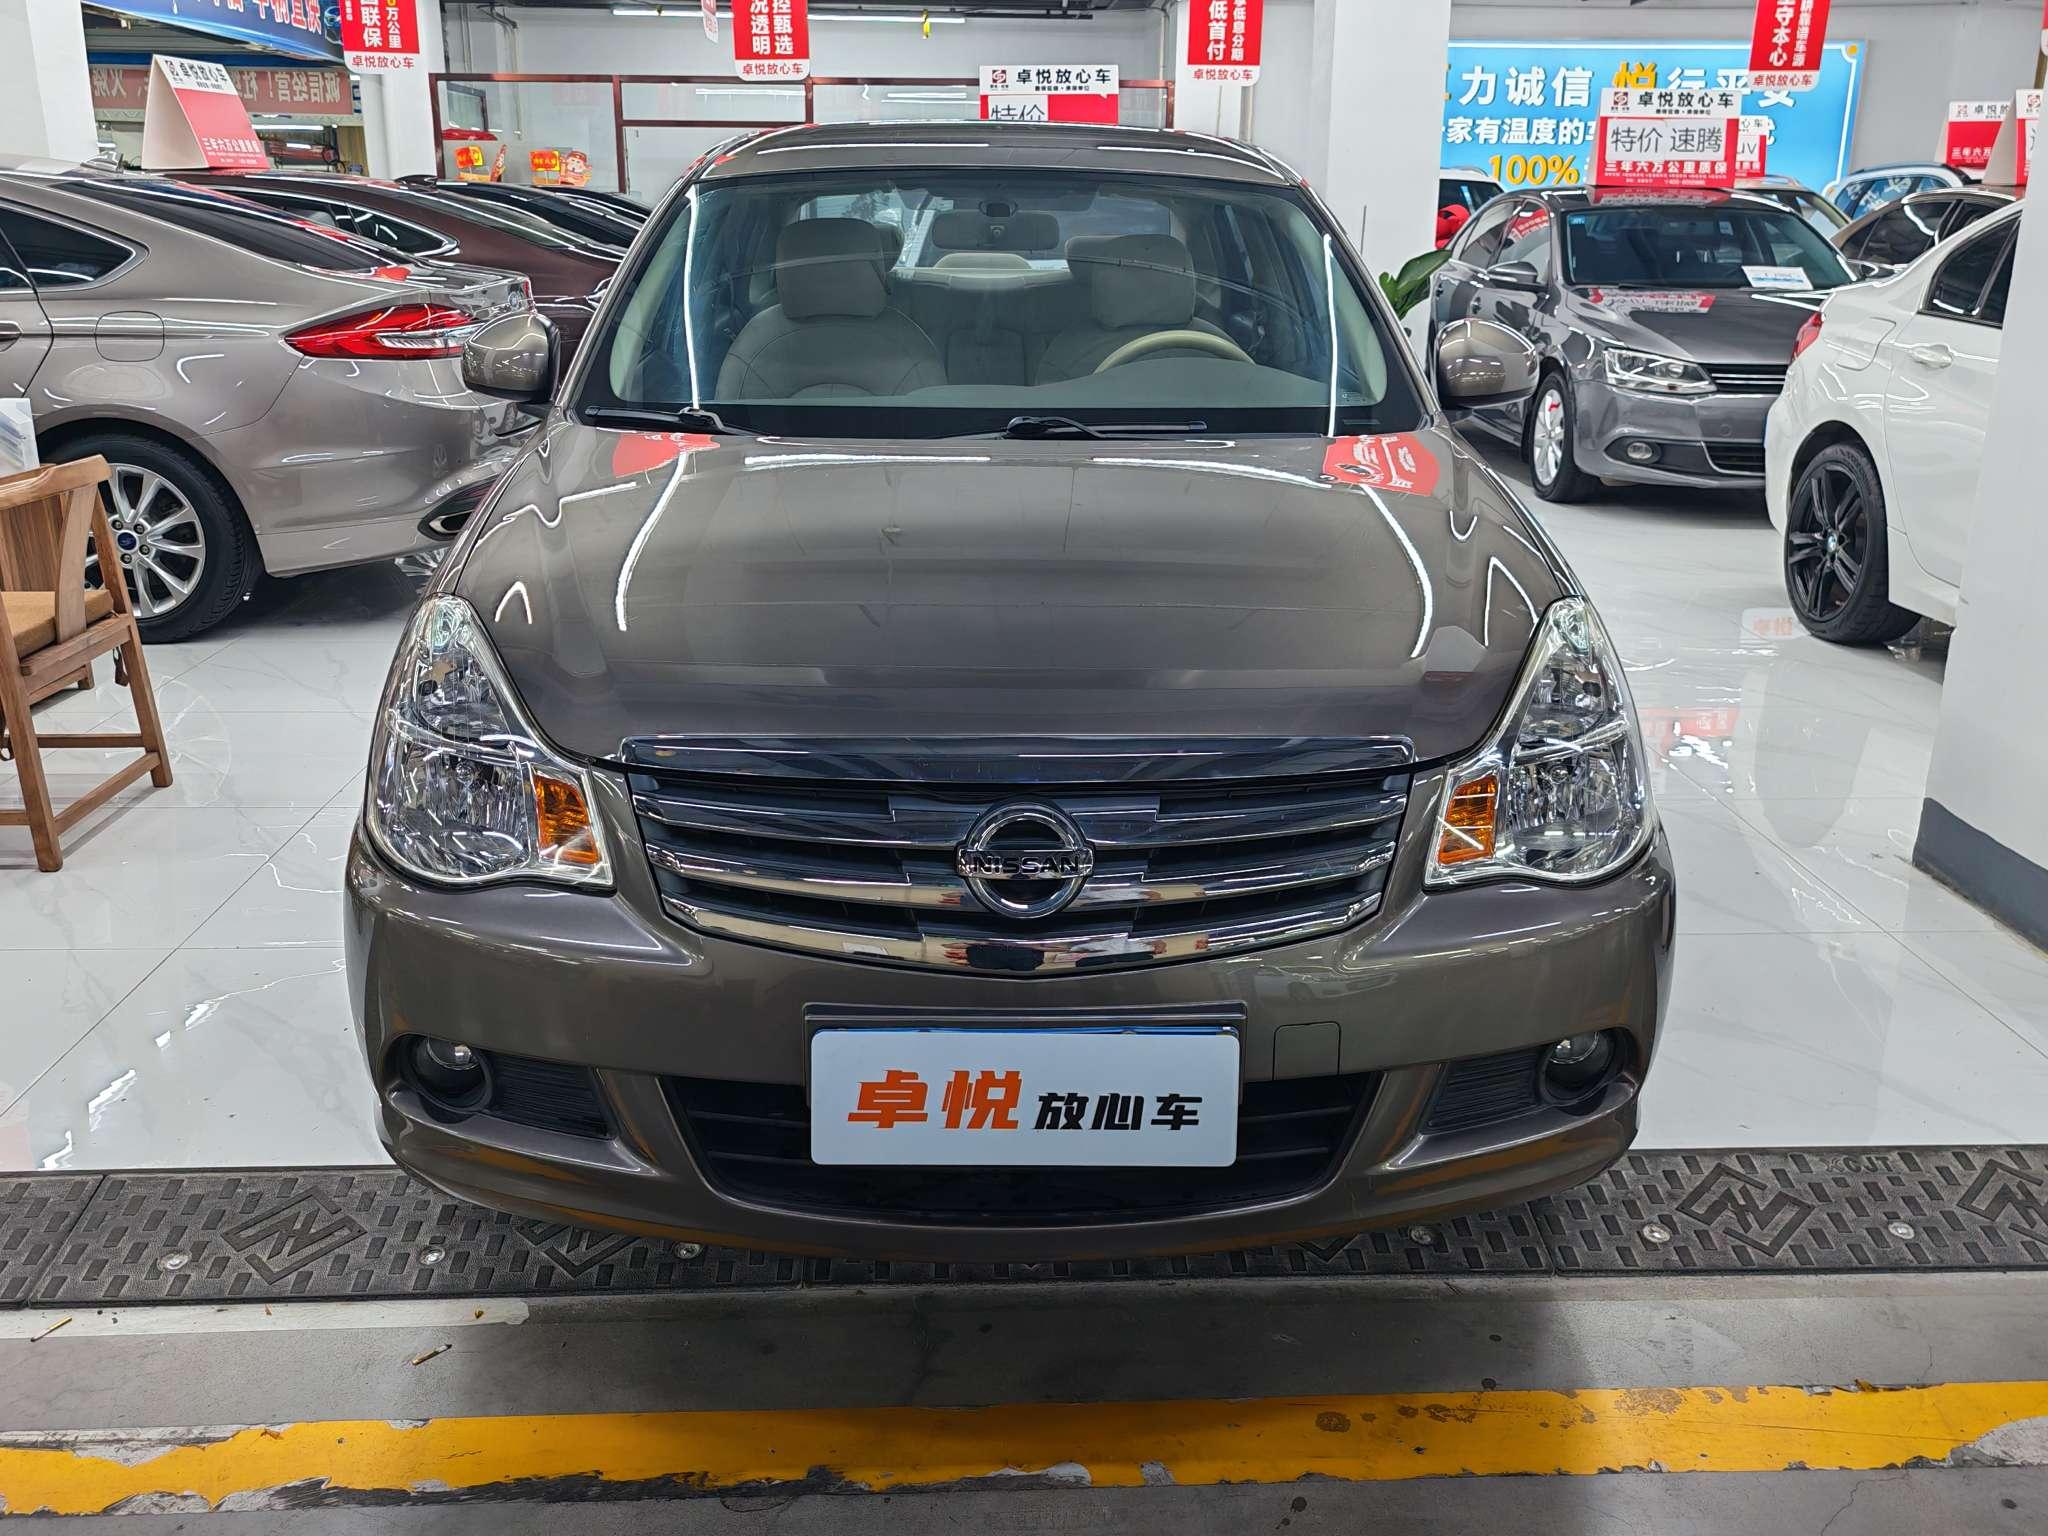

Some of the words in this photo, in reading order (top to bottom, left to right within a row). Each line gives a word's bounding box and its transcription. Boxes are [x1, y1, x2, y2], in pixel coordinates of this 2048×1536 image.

[361, 0, 382, 48] 联保
[1207, 0, 1228, 61] 低首付
[1769, 0, 1796, 67] 守本心
[352, 56, 414, 68] 卓悦放心车
[742, 63, 804, 75] 卓悦放心车
[1016, 68, 1112, 84] 卓悦放心车
[1193, 68, 1253, 80] 卓悦放心车
[1752, 74, 1812, 87] 卓悦放心车
[1638, 92, 1734, 108] 卓悦放心车
[1611, 127, 1664, 153] 特价
[1670, 126, 1723, 153] 速腾
[1490, 153, 1580, 186] 100%
[1604, 161, 1728, 174] 三年六万公里质保
[973, 855, 1081, 875] NISSAN
